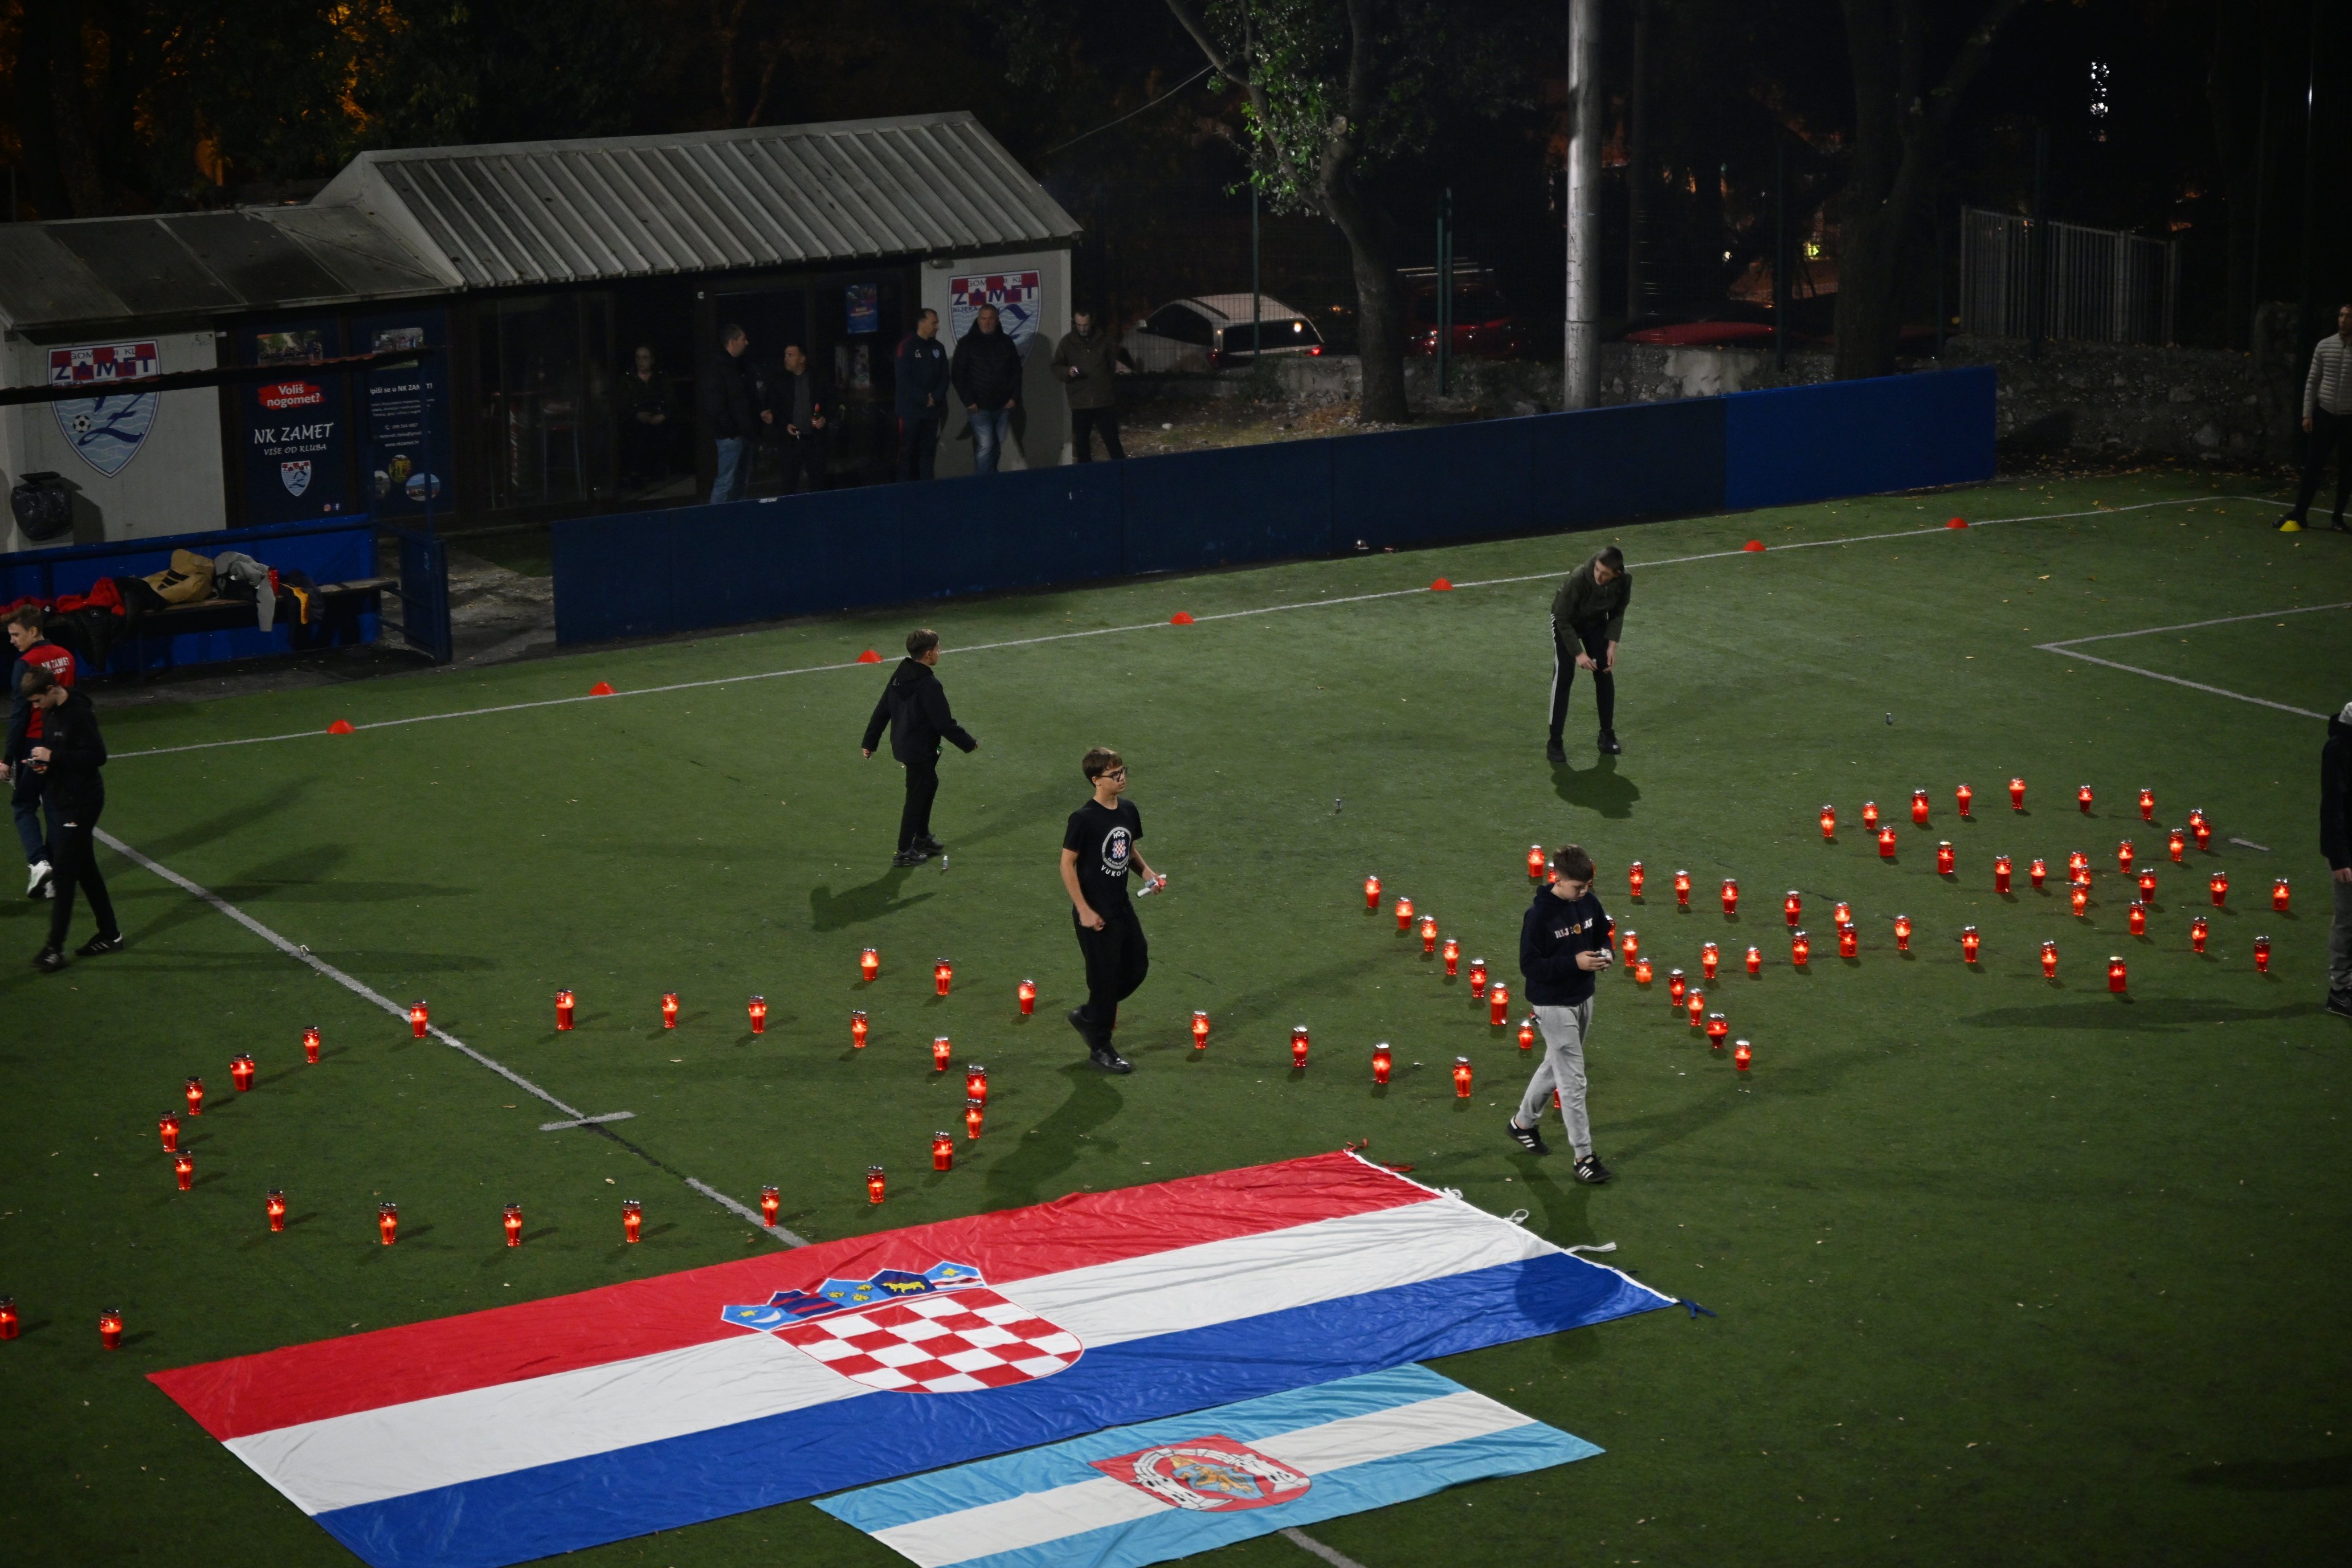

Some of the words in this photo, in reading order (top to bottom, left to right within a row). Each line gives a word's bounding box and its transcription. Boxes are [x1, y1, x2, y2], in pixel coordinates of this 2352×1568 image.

[953, 283, 1036, 305] ZAMET
[54, 354, 154, 381] ZAMET
[278, 384, 304, 395] Voliš
[267, 393, 321, 408] nogomet?
[254, 428, 276, 444] NK
[281, 422, 334, 442] ZAMET
[264, 446, 283, 455] VIŠE
[299, 443, 327, 452] KLUBA
[1113, 831, 1125, 839] HOS
